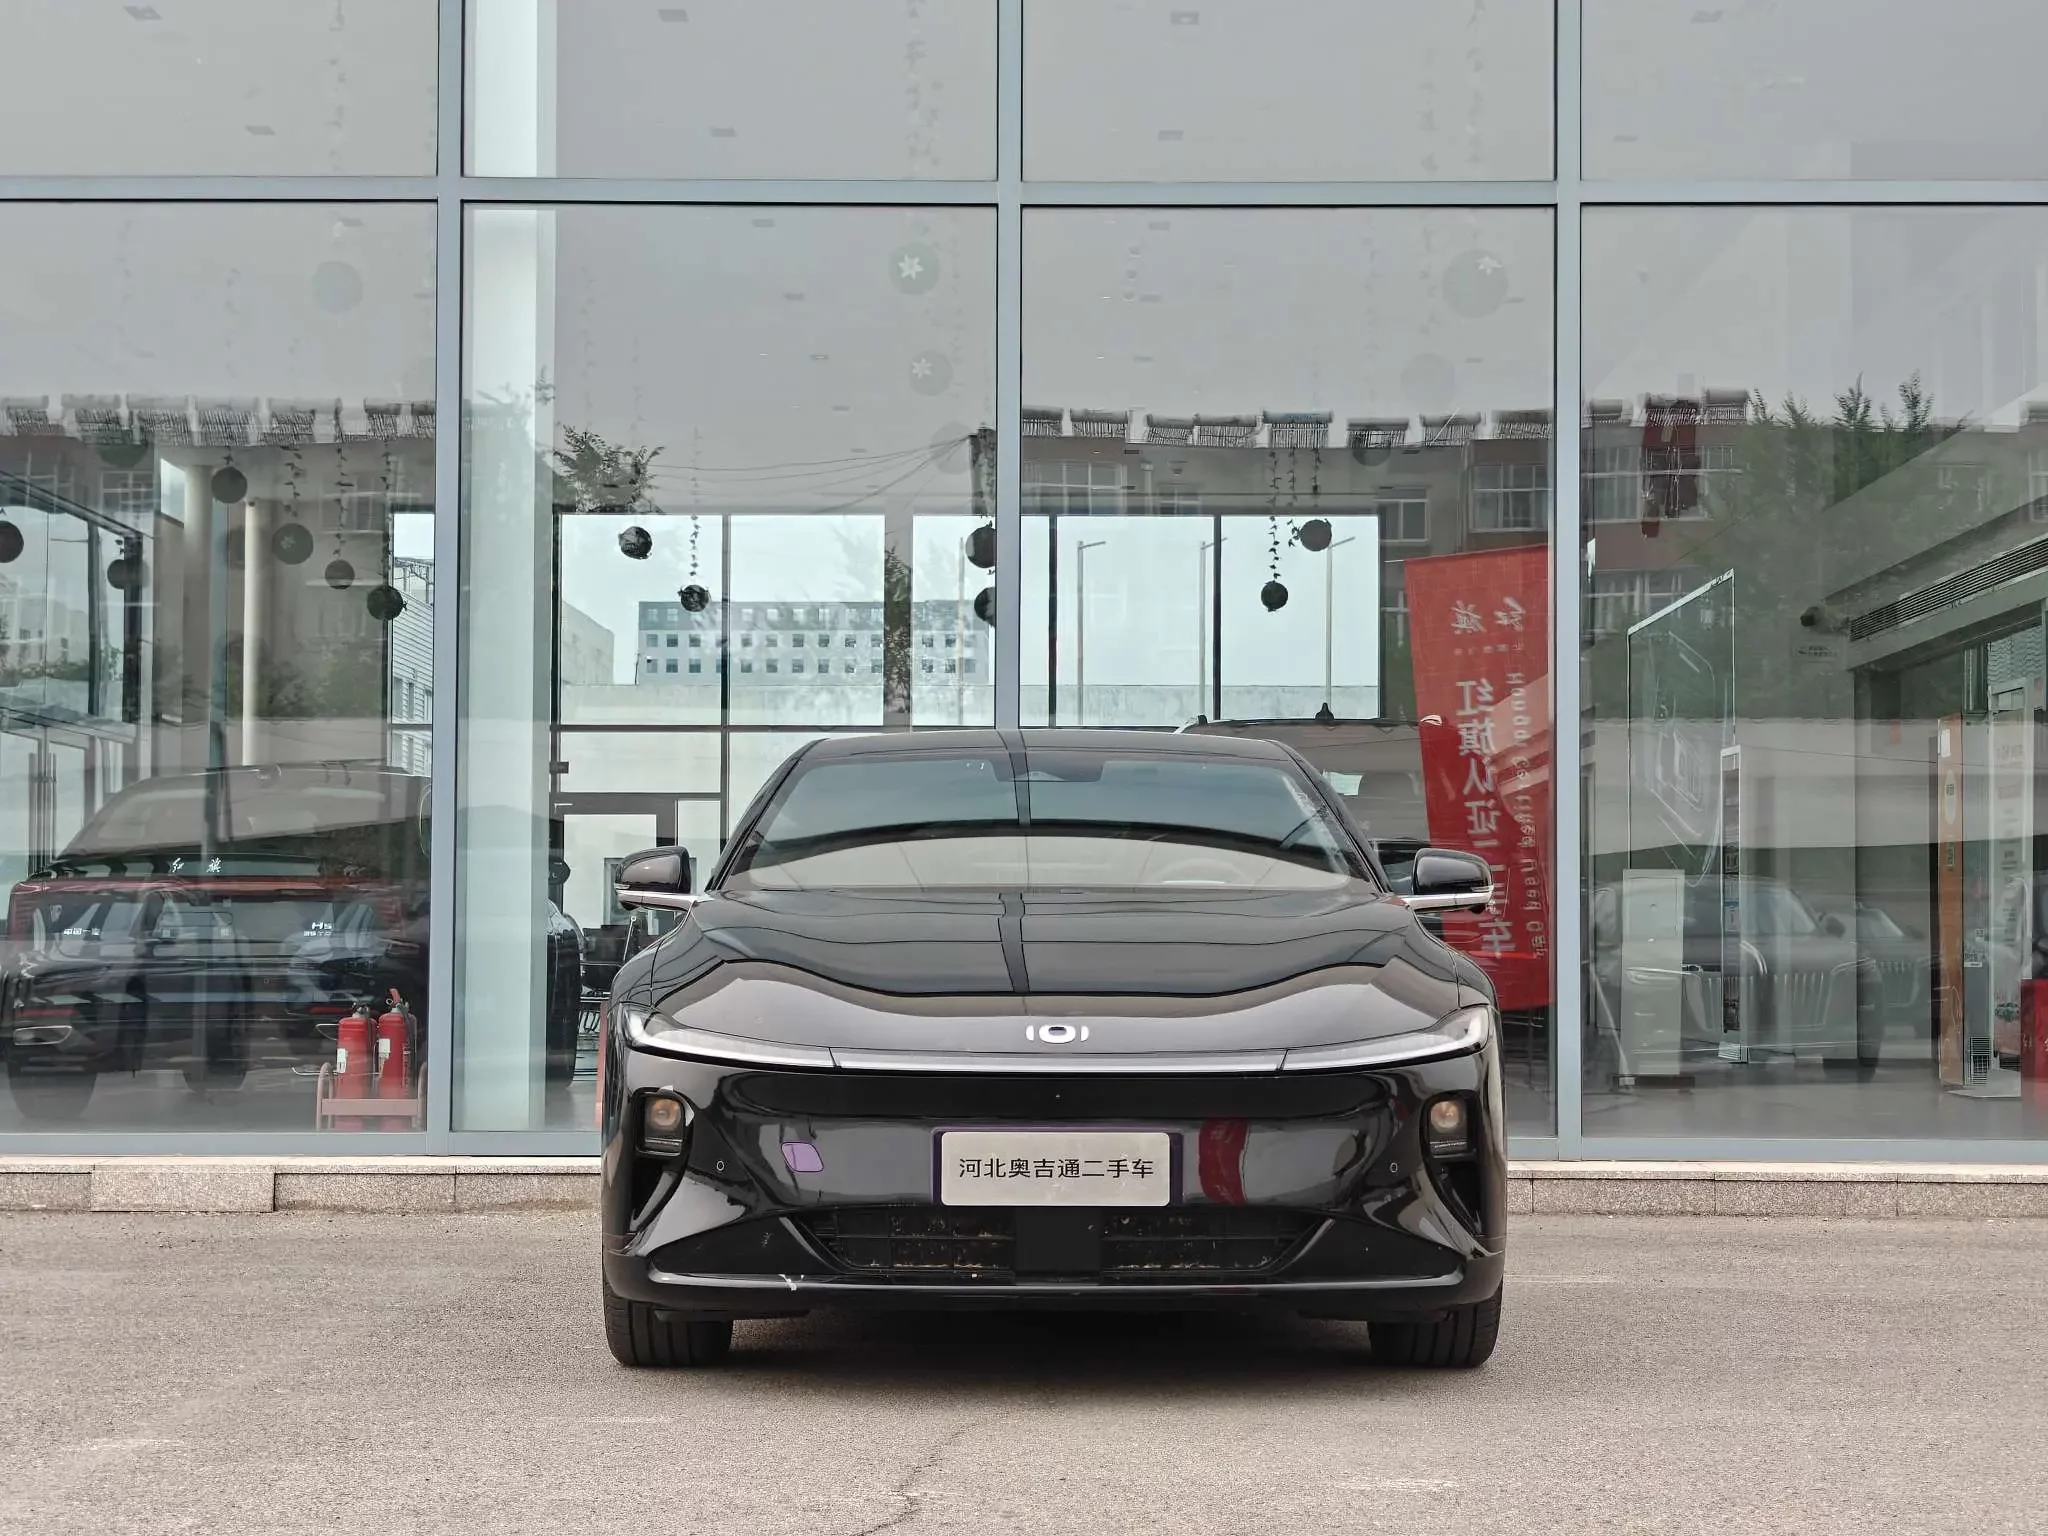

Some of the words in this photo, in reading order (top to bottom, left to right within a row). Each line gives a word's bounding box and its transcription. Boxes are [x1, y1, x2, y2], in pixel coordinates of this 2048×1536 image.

[959, 1158, 1154, 1179] 河北奥吉通二手车
